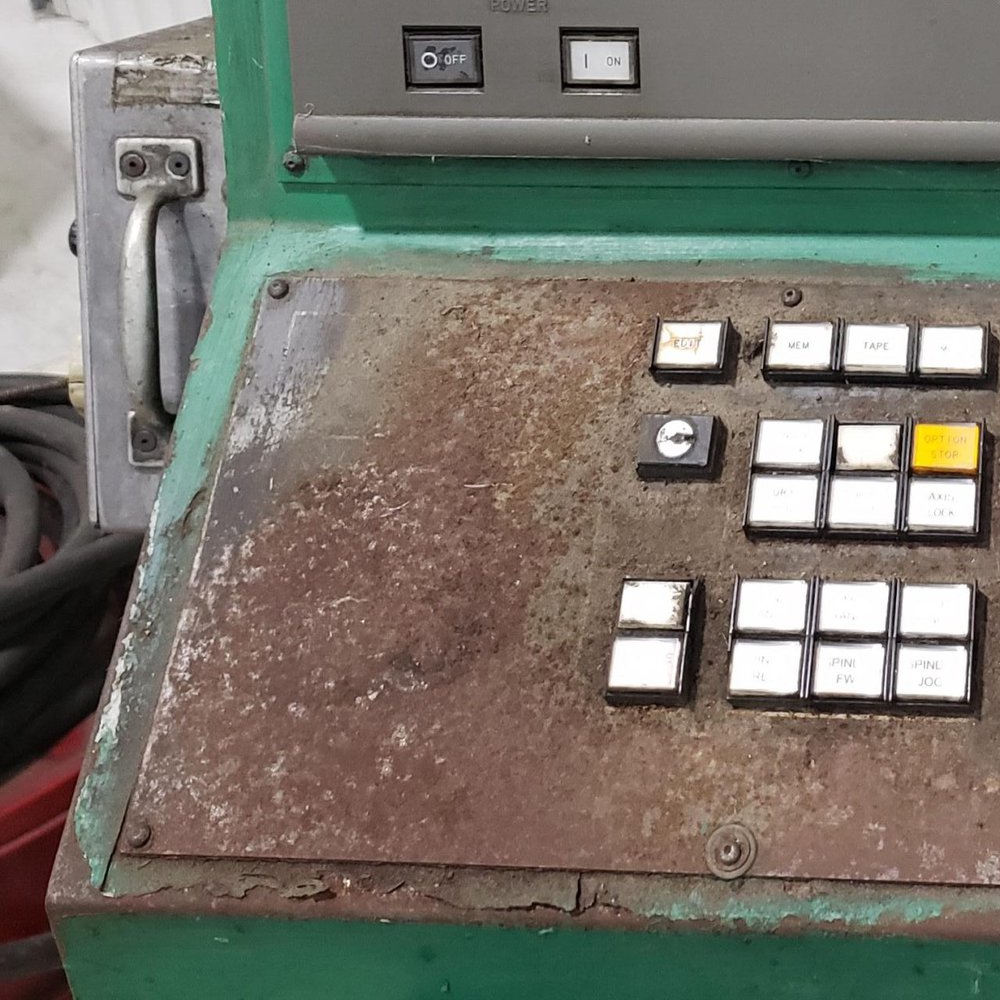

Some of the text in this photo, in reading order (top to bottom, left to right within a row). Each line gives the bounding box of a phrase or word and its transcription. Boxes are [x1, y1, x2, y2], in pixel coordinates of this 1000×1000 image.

[443, 54, 468, 66] OFF
[606, 55, 622, 67] ON
[787, 340, 811, 351] MEM
[863, 340, 890, 352] TAPE
[923, 434, 968, 445] OPTION
[930, 450, 960, 460] STOP
